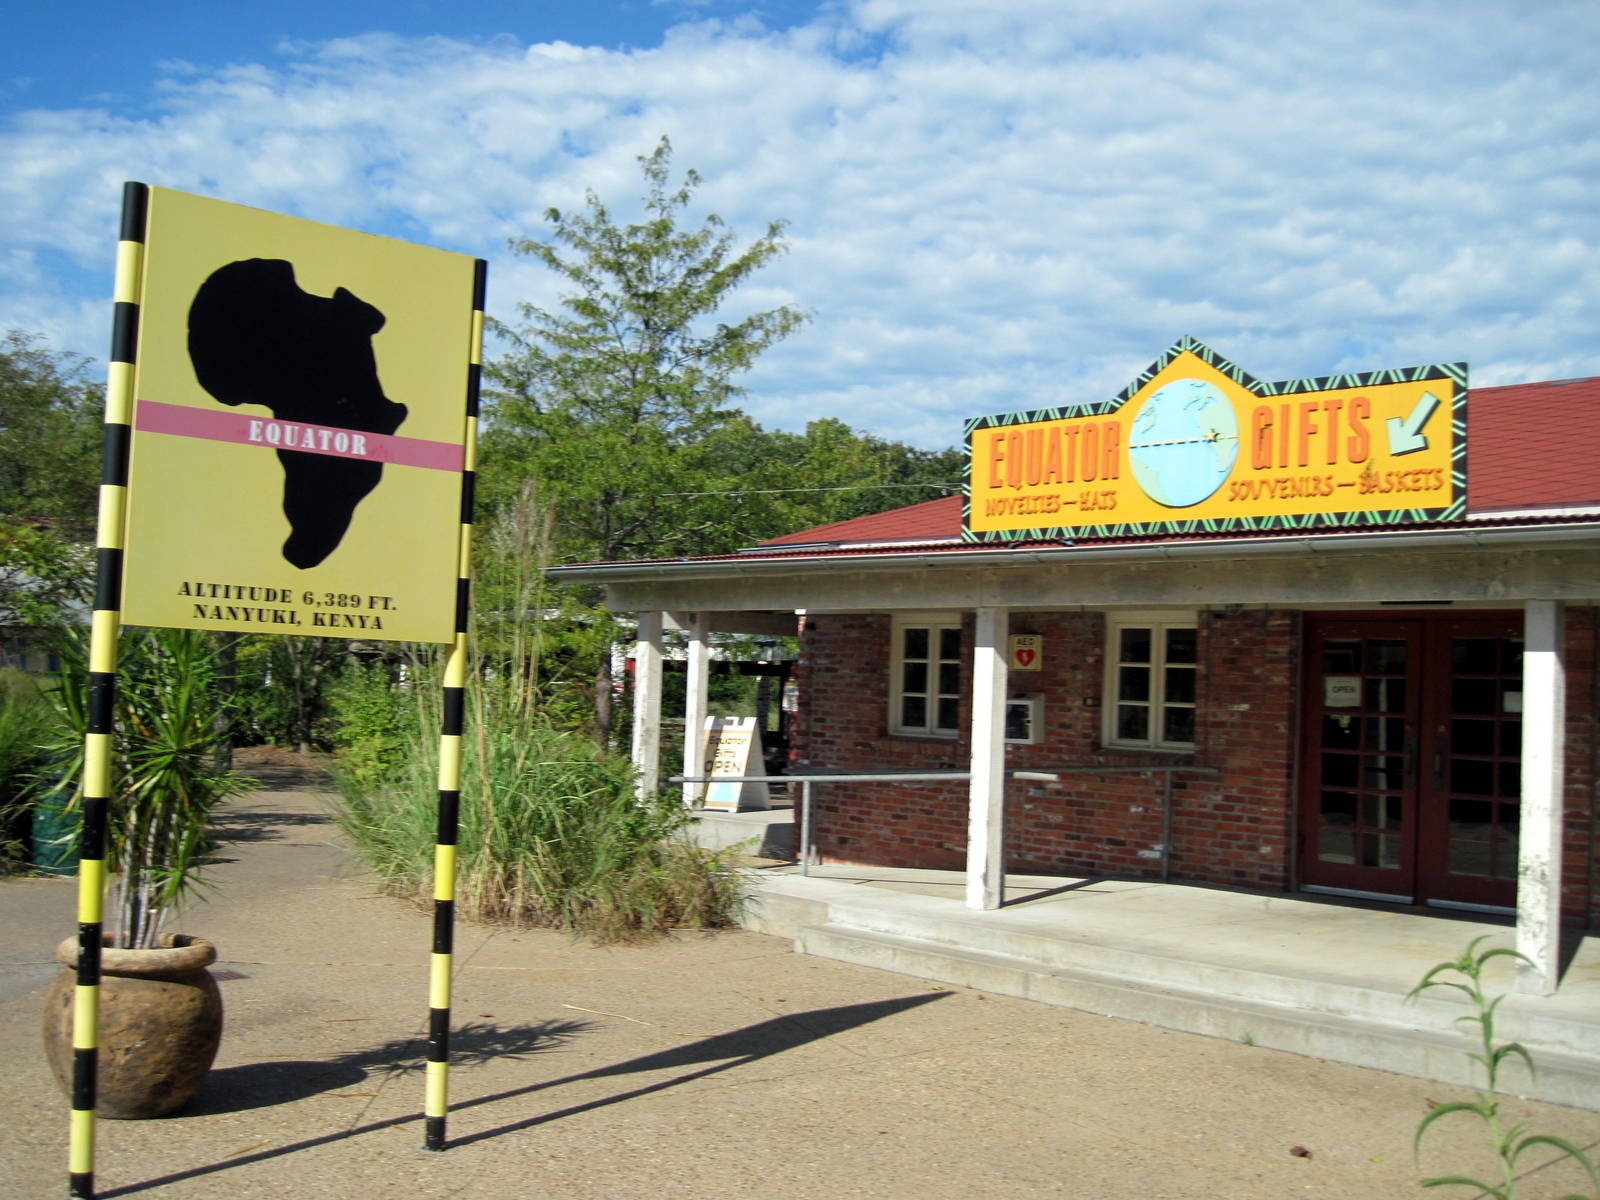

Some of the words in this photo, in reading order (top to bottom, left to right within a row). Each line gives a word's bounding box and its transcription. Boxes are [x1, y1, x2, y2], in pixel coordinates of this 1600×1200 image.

[248, 420, 367, 455] EQUATOR
[989, 421, 1121, 490] EQUATOR
[1251, 396, 1371, 470] GIFTS
[177, 581, 292, 603] ALTITUDE
[303, 591, 361, 608] 6,389
[368, 595, 397, 610] FT.
[193, 603, 302, 626] NANYUKI,
[312, 612, 384, 629] KENYA
[705, 760, 742, 773] OPEN
